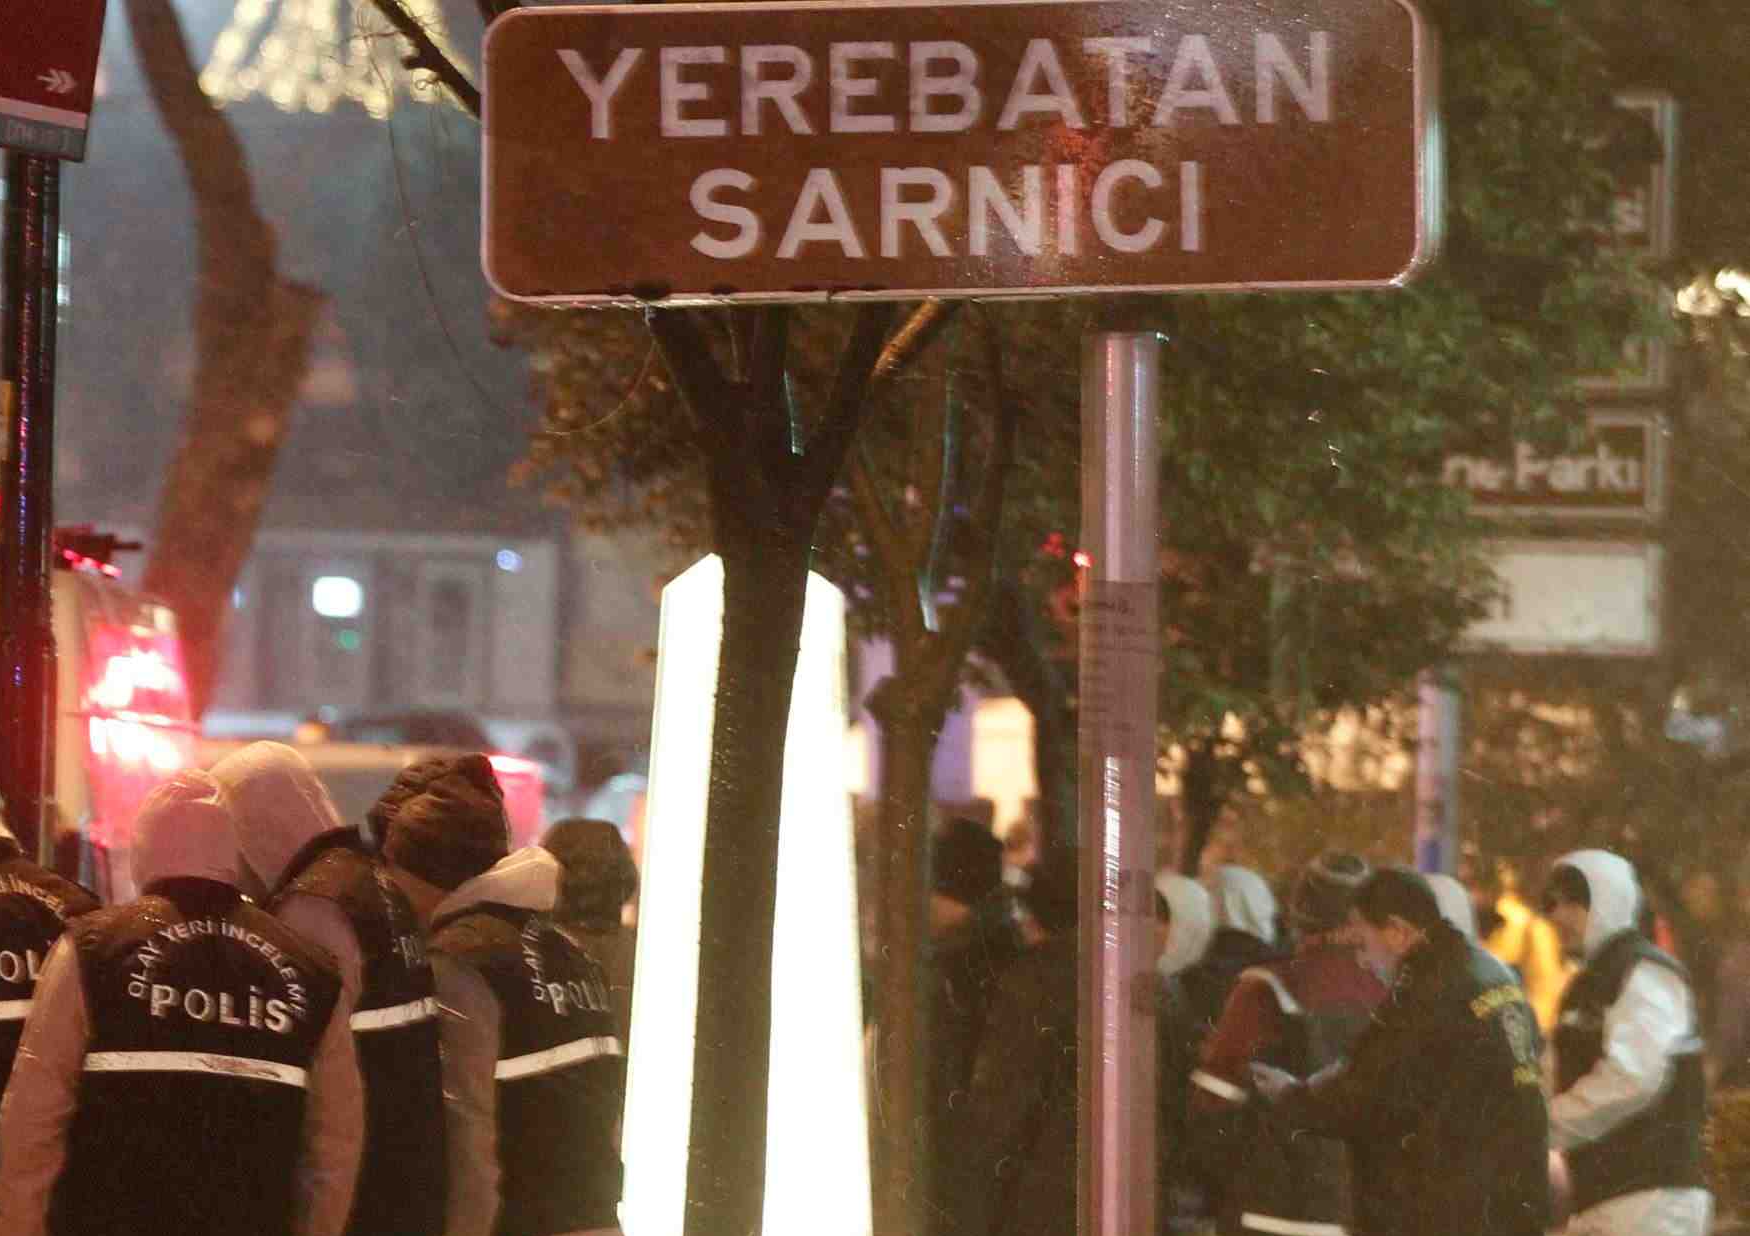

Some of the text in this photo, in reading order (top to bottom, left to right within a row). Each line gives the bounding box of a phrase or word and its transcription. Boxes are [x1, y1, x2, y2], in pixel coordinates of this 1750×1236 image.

[556, 30, 1332, 140] YEREBATAN
[689, 160, 1202, 260] SARNICI
[127, 940, 163, 999] OLAY
[157, 915, 213, 943] YERİ
[149, 983, 293, 1034] POLİS
